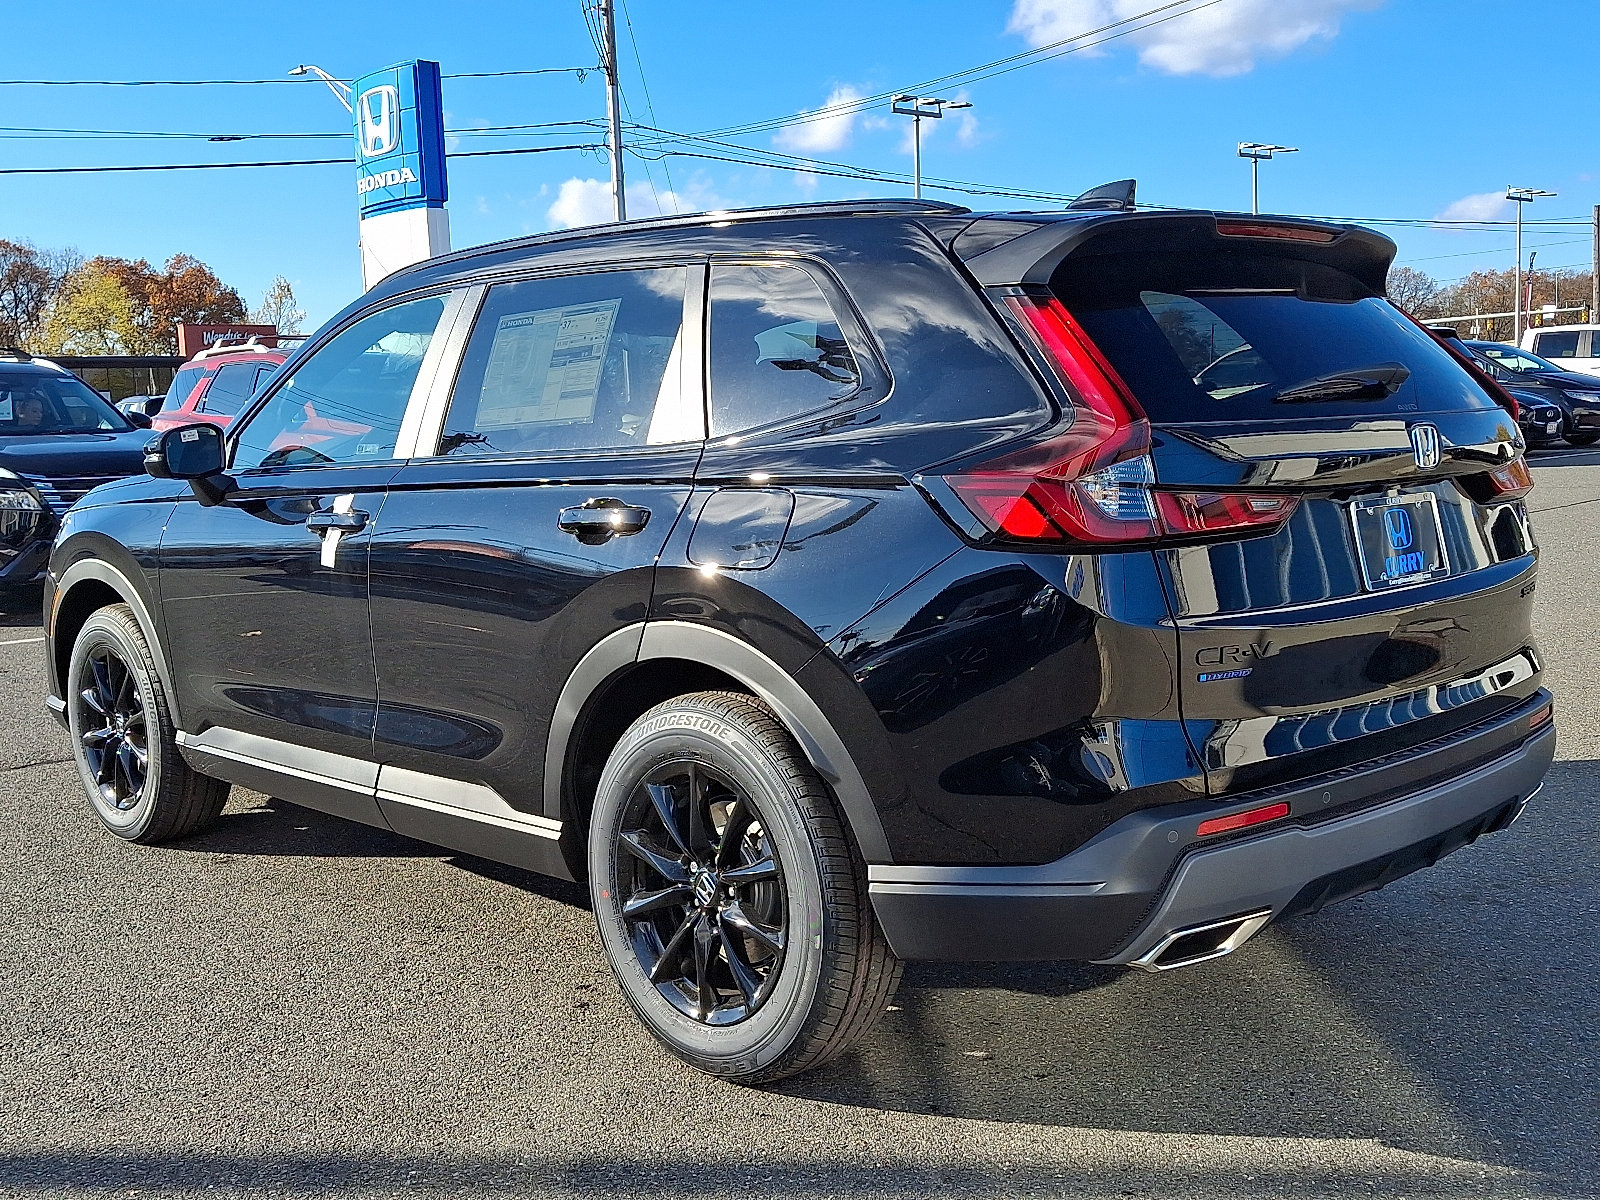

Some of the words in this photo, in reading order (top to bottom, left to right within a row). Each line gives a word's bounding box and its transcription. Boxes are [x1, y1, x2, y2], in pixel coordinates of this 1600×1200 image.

[357, 167, 418, 195] HONDA
[507, 317, 533, 329] HONDA
[1397, 403, 1418, 411] AWD
[1385, 551, 1425, 578] CURRY
[1195, 640, 1274, 667] CR-V
[1207, 668, 1253, 681] HYBRID
[141, 676, 161, 770] BRIDGESNE
[637, 714, 732, 740] BRIDGESTONE
